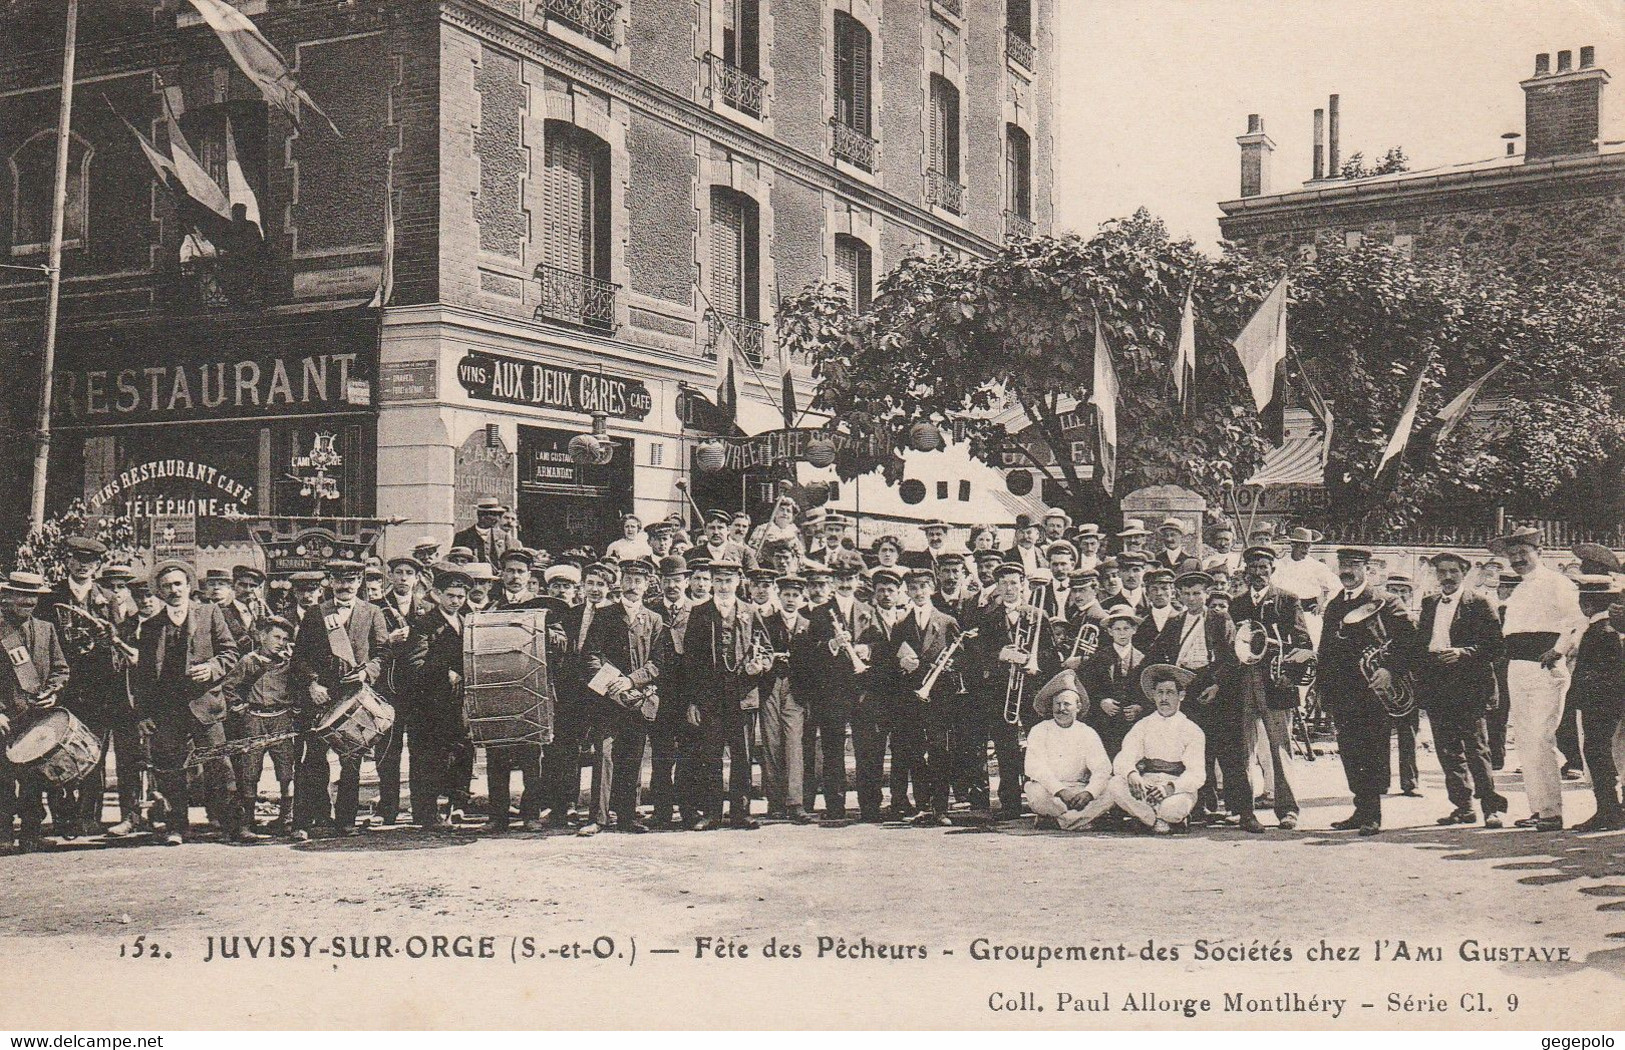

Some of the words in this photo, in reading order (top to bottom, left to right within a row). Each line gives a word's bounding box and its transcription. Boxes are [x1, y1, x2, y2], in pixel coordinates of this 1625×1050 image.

[460, 364, 487, 384] VINS
[492, 361, 525, 400] AUX
[532, 365, 573, 407] DEUX
[580, 374, 626, 415] GARES
[91, 480, 121, 509] VINS
[120, 459, 217, 488] RESTAURANT
